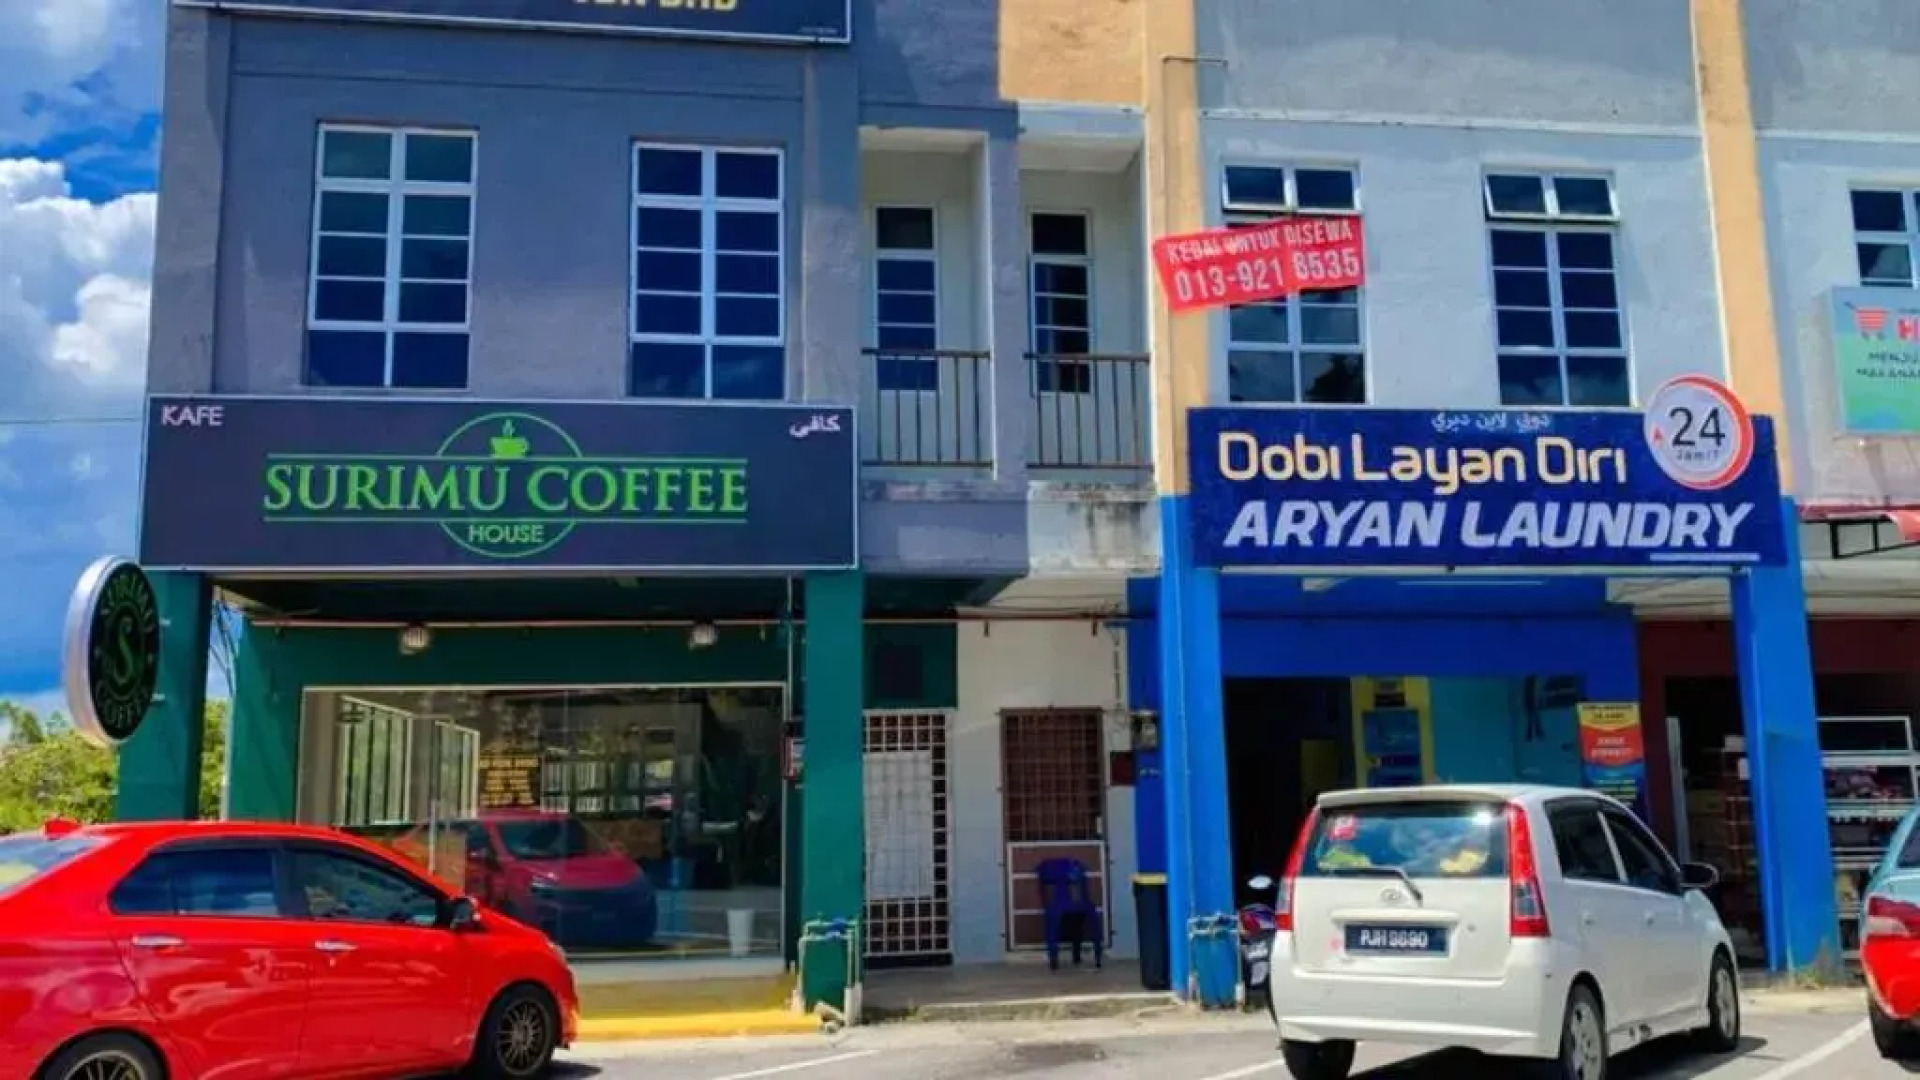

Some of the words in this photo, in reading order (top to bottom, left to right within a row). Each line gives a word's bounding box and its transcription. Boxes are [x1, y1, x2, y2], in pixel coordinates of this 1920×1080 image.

[1174, 258, 1284, 302] 013-921
[161, 405, 224, 427] KAFE
[1668, 405, 1726, 447] 24
[1217, 431, 1341, 481] Dobi
[1351, 432, 1527, 495] Layan
[1535, 436, 1627, 484] Diri
[263, 463, 511, 511] SURIMU
[526, 465, 749, 513] COFFEE
[467, 524, 544, 543] HOUSE
[1222, 500, 1448, 548] ARYAN
[1459, 501, 1755, 548] LAUNDRY
